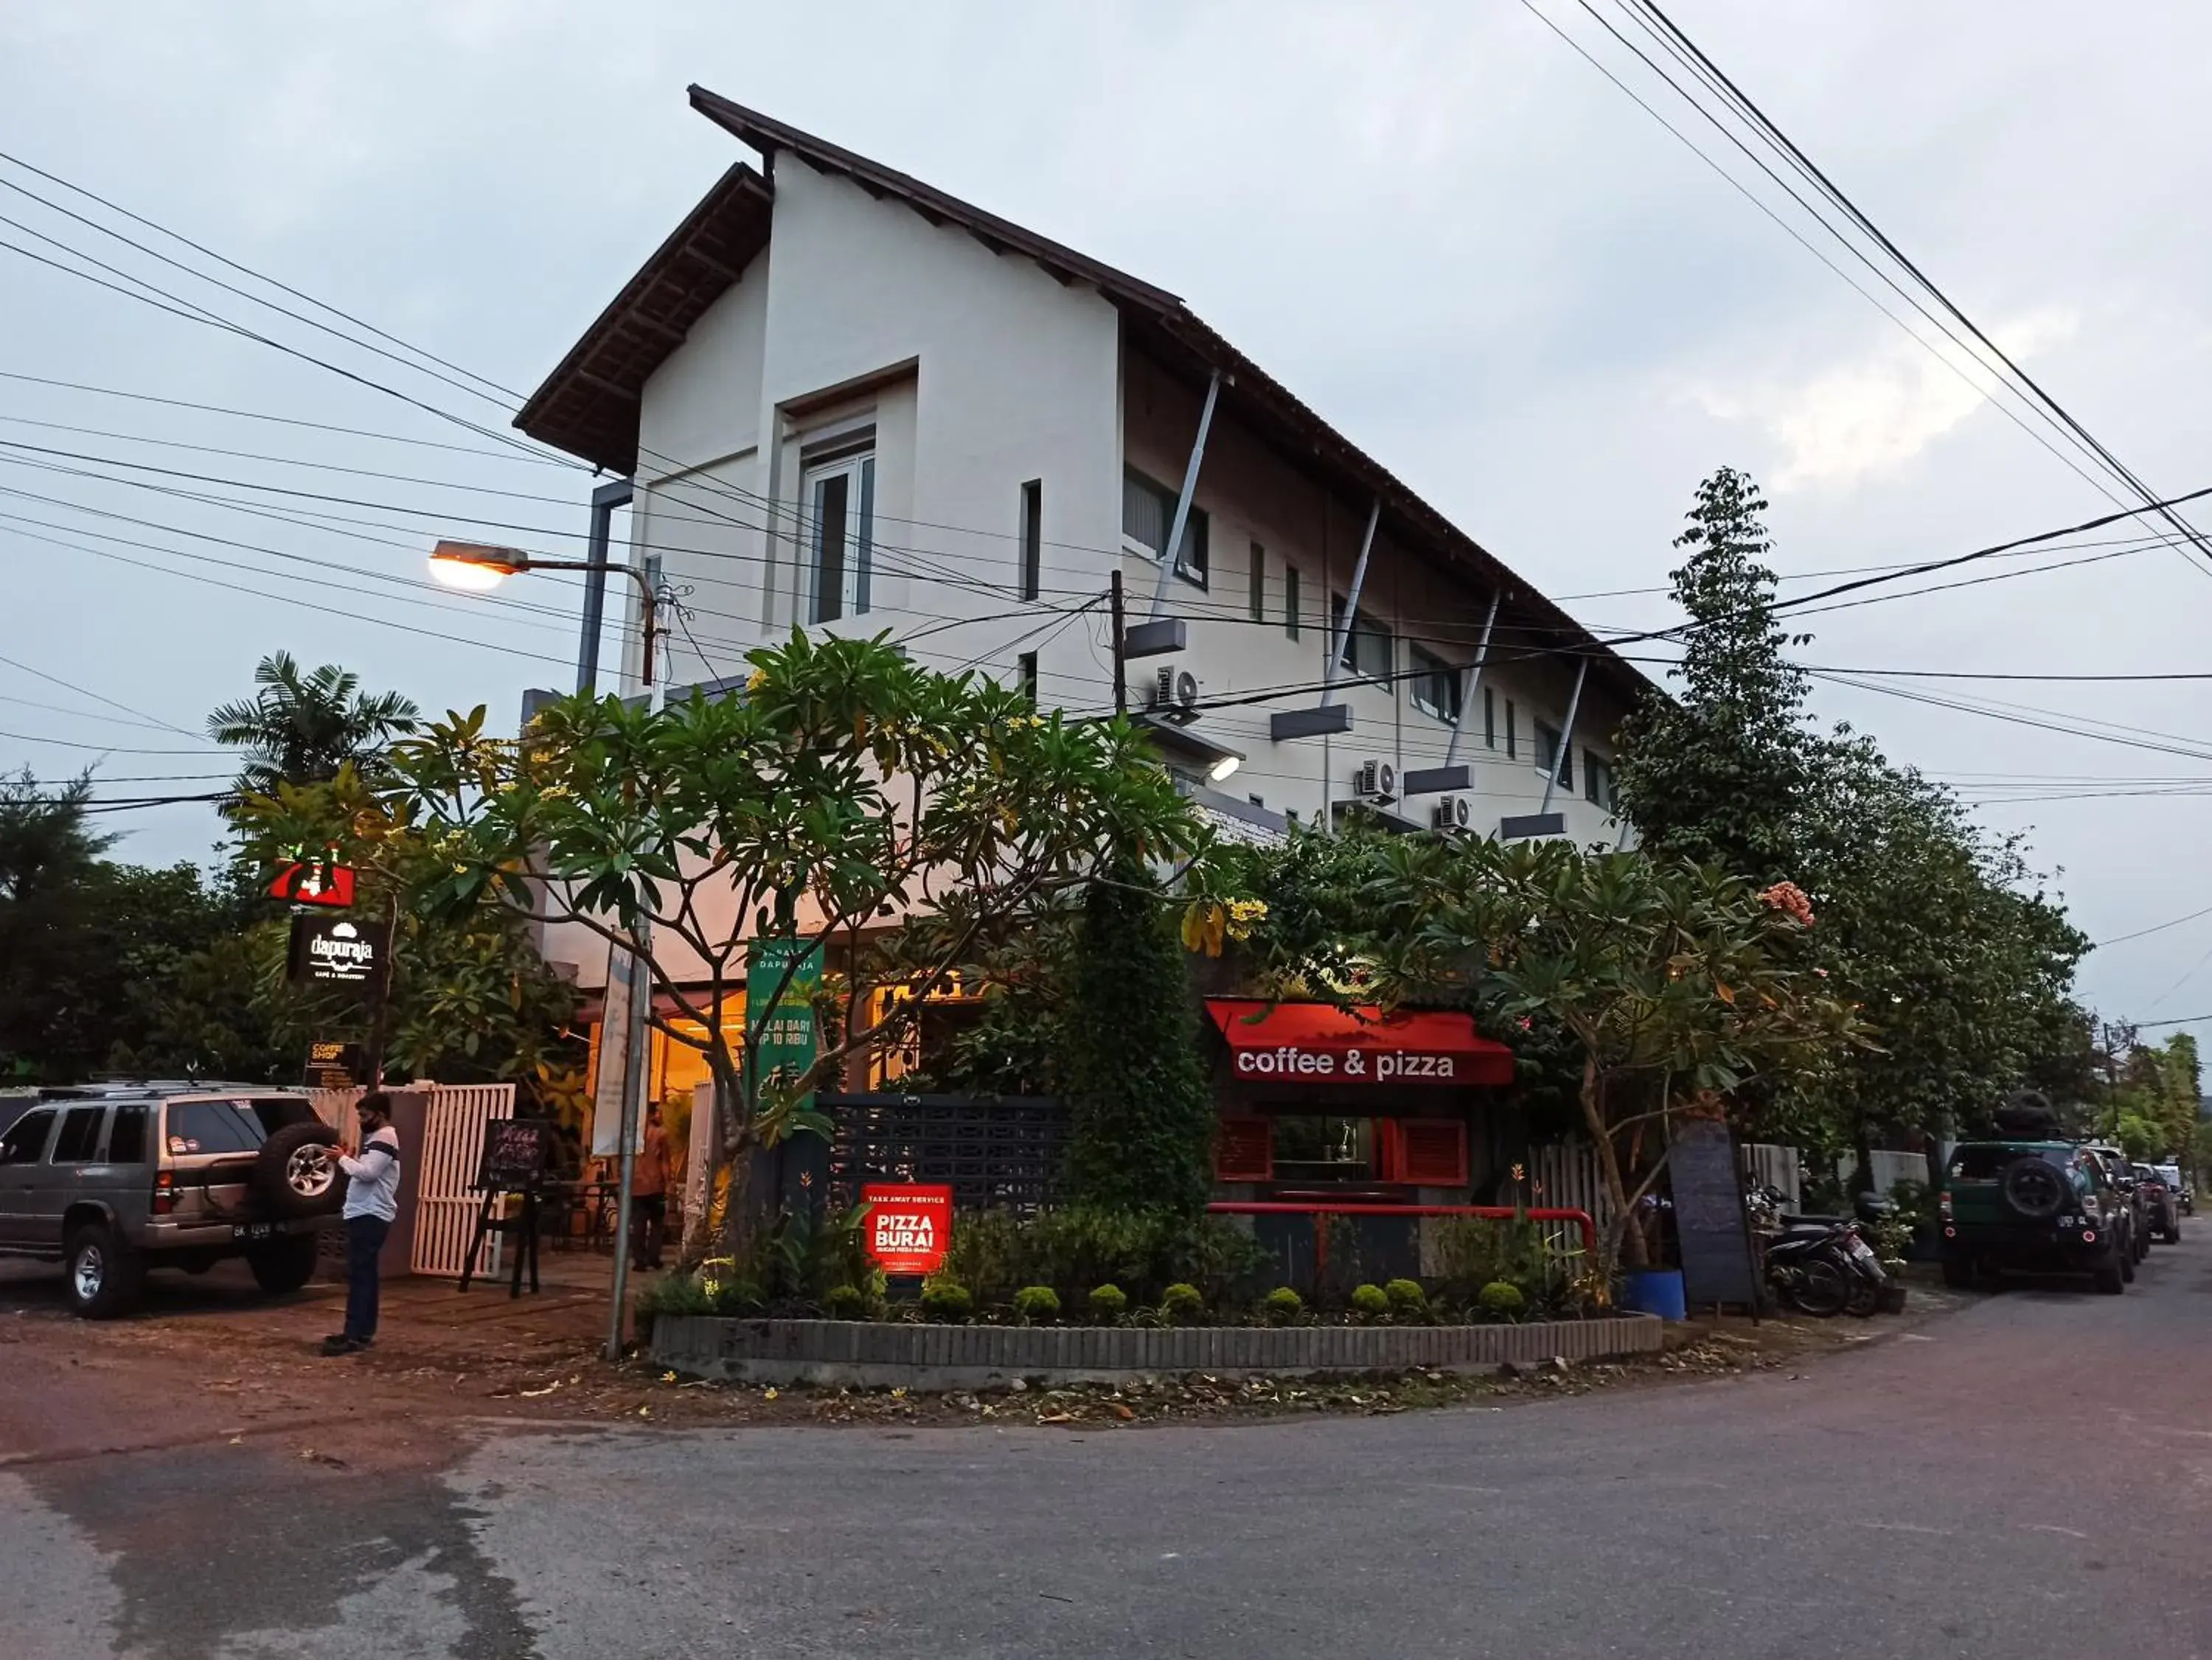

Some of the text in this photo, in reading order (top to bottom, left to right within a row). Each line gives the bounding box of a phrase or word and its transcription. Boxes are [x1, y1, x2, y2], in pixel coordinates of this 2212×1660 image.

[310, 933, 374, 963] dapuraja
[760, 960, 814, 971] DAPUJA
[751, 1019, 810, 1033] MLAI DARI
[773, 1033, 782, 1045] 10
[1237, 1046, 1455, 1082] coffee & pizza
[877, 1215, 933, 1230] PIZZA
[875, 1231, 933, 1247] BURAI
